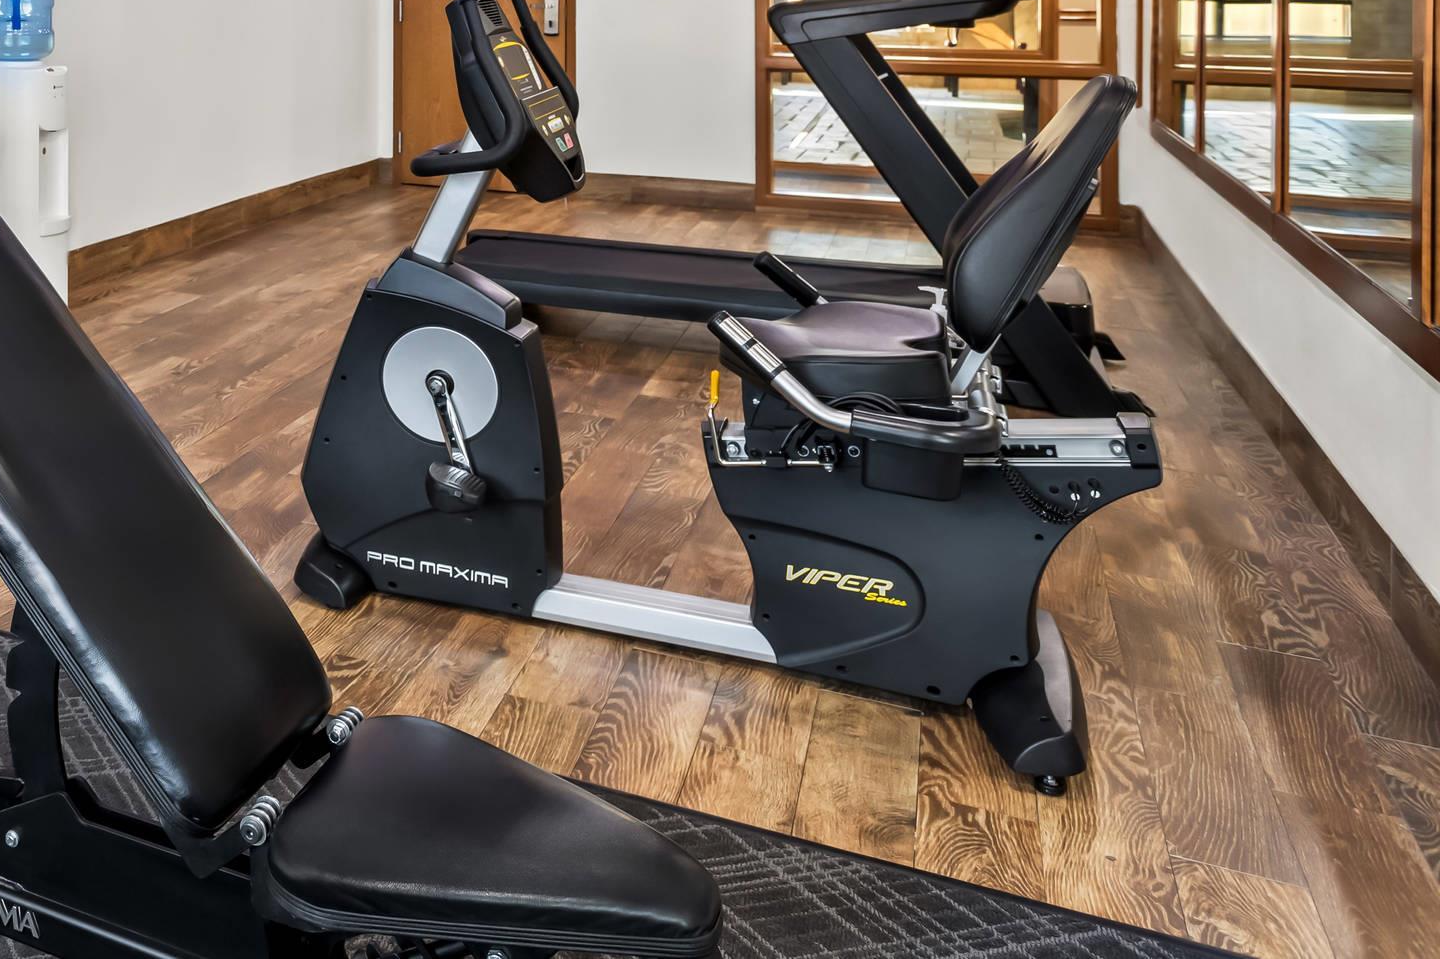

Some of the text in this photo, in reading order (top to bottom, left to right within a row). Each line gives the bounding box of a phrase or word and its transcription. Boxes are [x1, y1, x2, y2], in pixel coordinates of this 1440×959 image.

[366, 550, 509, 589] PRO MAXIMA
[785, 564, 895, 597] VIPER
[864, 592, 908, 607] Series
